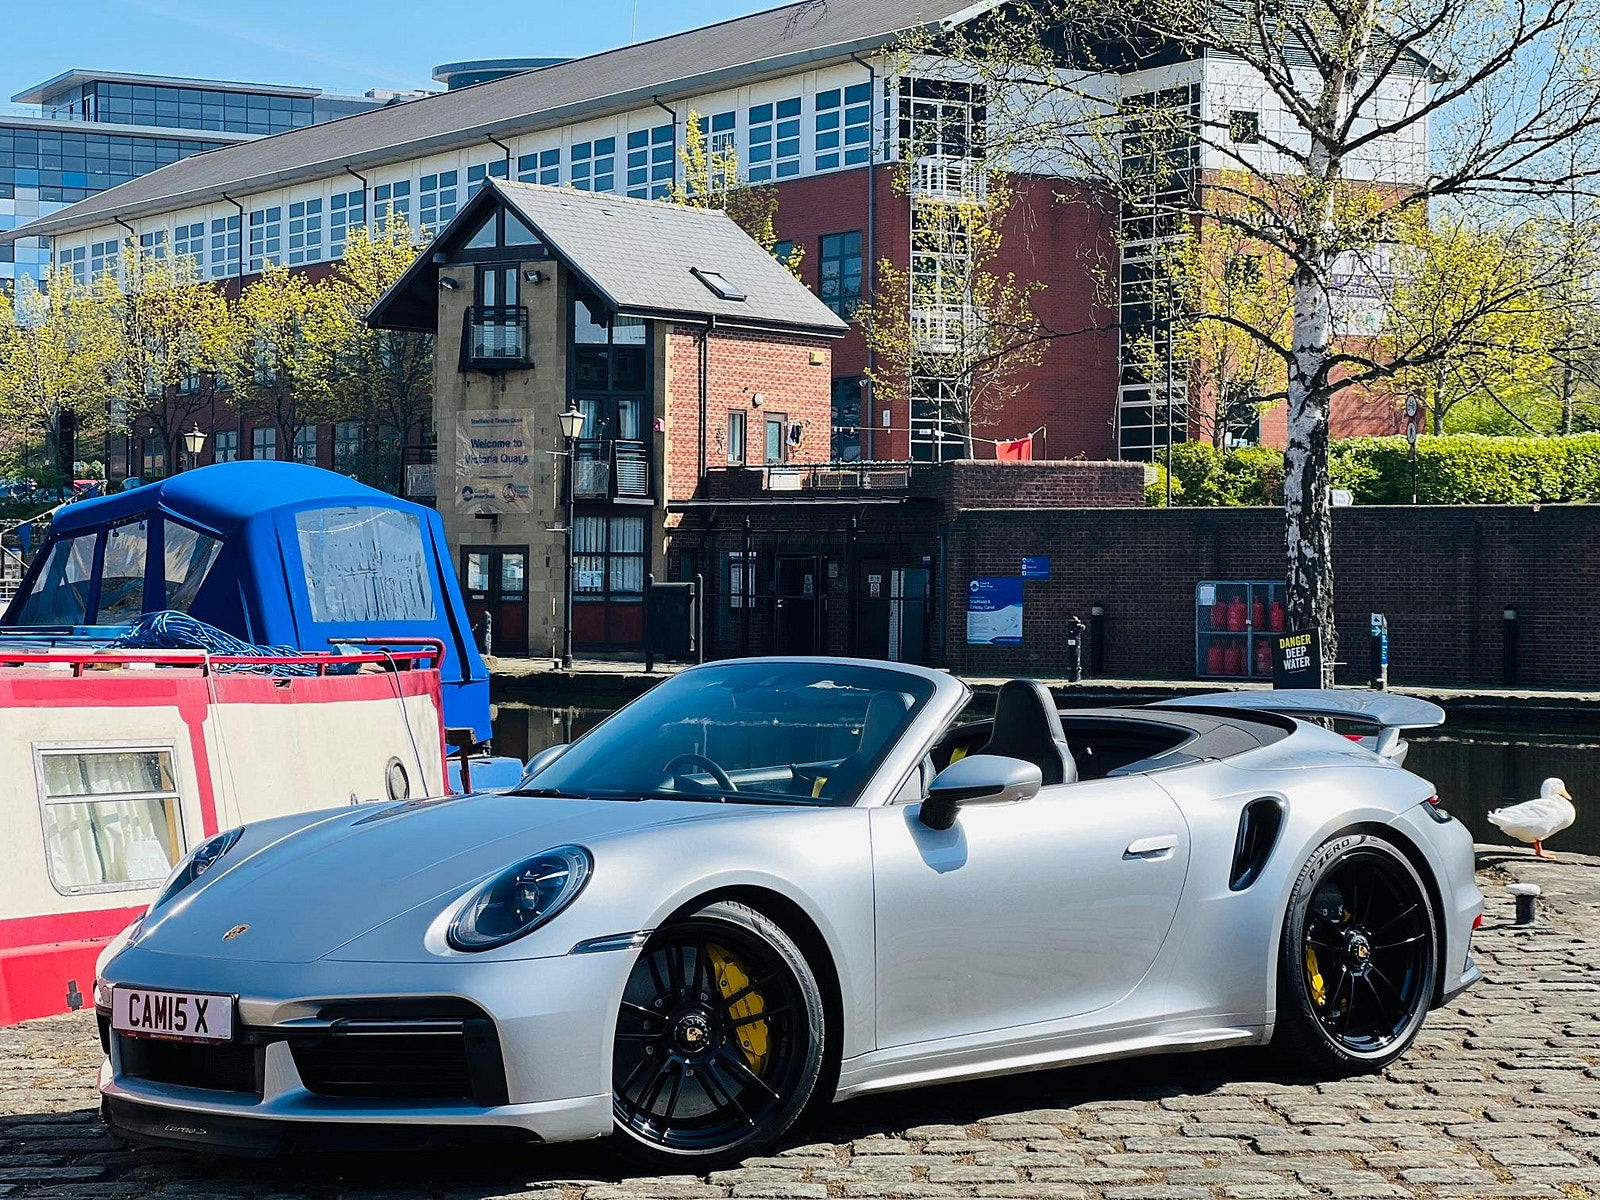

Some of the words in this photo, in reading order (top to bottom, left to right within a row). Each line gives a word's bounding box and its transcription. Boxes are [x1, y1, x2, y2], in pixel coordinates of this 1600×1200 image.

[471, 439, 511, 448] Welcome
[513, 439, 523, 448] to
[465, 454, 498, 464] Victoria
[500, 453, 529, 465] Quays
[1280, 634, 1311, 649] DANGER
[1286, 646, 1306, 659] DEEP
[1283, 656, 1310, 670] WATER
[1309, 868, 1316, 882] P
[1317, 839, 1349, 869] ZERO
[129, 993, 187, 1031] CAM15
[194, 998, 208, 1033] X
